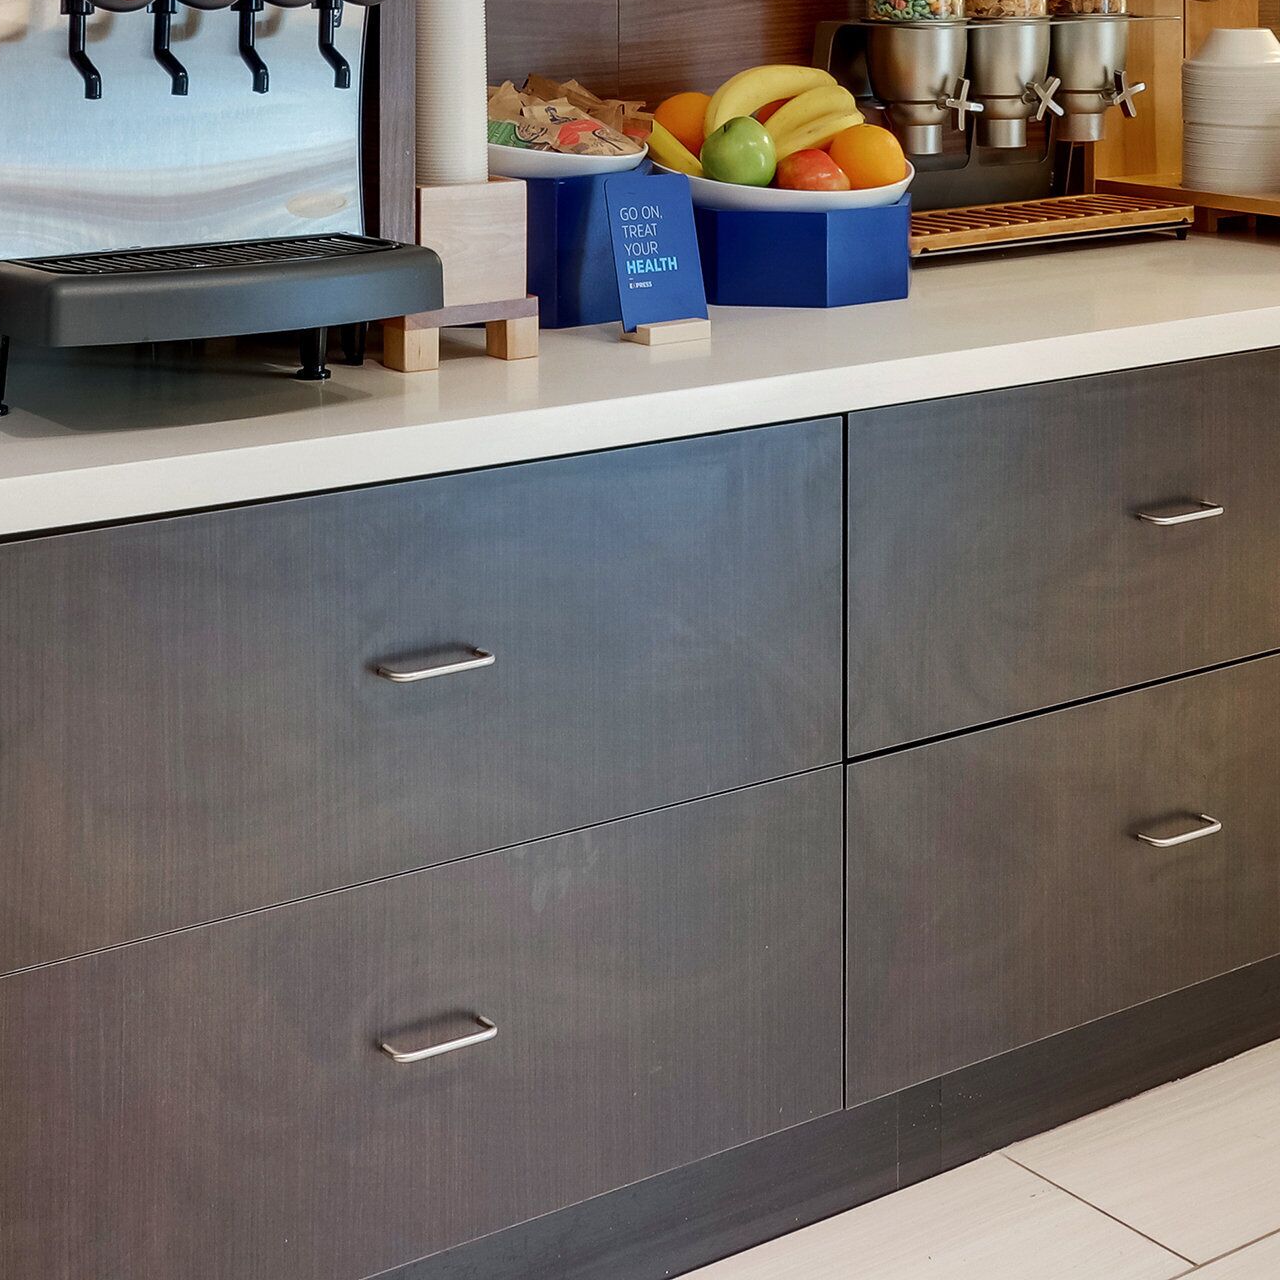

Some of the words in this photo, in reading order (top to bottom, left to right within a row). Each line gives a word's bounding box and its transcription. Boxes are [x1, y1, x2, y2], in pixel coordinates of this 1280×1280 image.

[620, 206, 638, 221] GO
[641, 205, 663, 220] ON,
[621, 223, 657, 239] TREAT
[623, 241, 659, 256] YOUR
[626, 256, 678, 275] HEALTH
